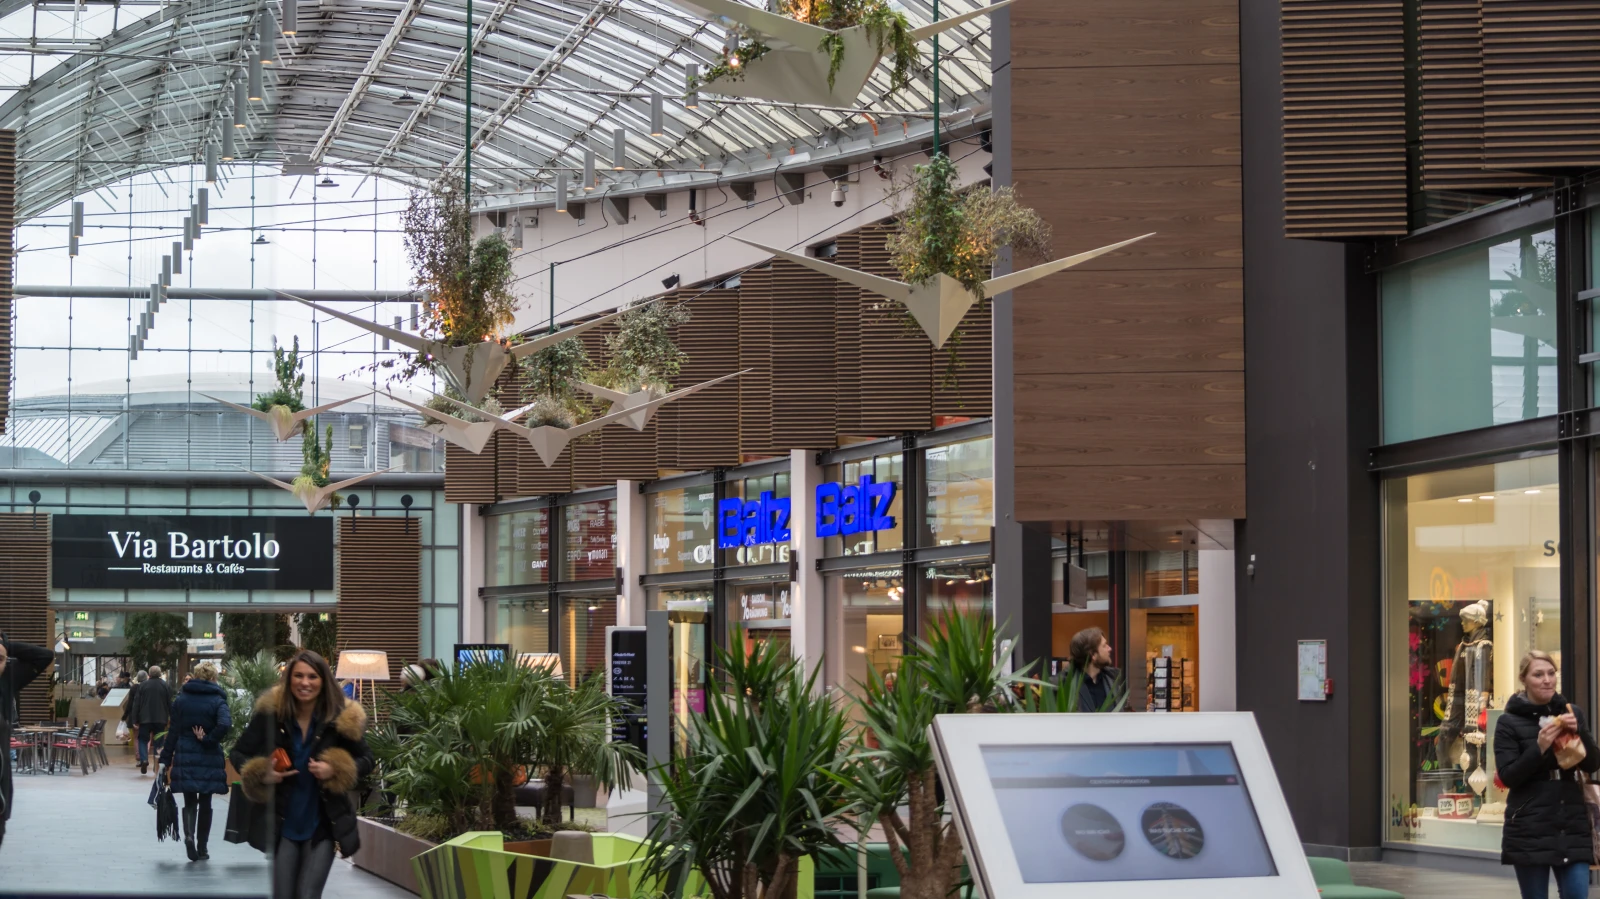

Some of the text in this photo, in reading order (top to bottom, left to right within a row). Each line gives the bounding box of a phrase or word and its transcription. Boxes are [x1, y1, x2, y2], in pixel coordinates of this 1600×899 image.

[719, 490, 791, 549] Baltz
[816, 474, 897, 538] Baltz
[107, 531, 280, 559] Via Bartolo
[143, 562, 245, 574] Restaurants & Cafés
[531, 560, 548, 569] GANT
